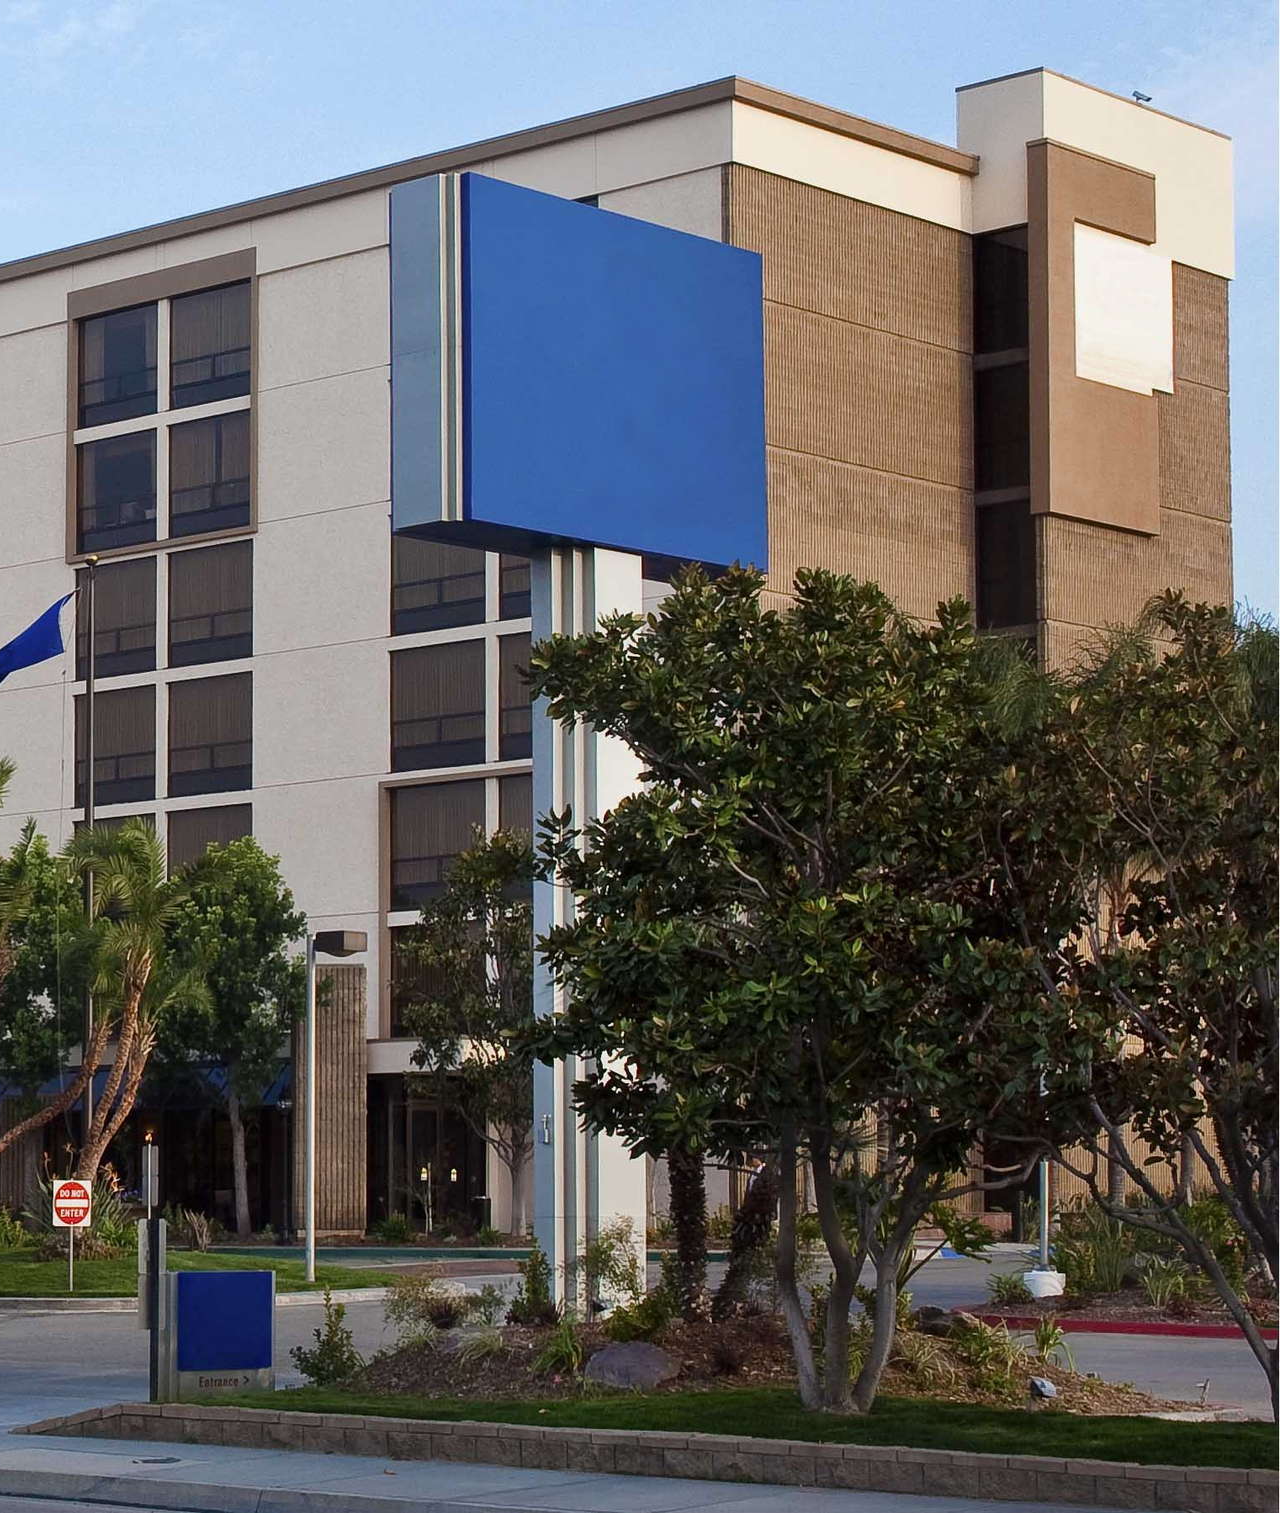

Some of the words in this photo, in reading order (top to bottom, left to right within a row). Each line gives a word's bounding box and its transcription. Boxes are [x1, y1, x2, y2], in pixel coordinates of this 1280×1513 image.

[60, 1190, 70, 1198] DO
[71, 1190, 85, 1198] NOT
[60, 1209, 84, 1218] ENTER
[199, 1376, 239, 1388] Entrance
